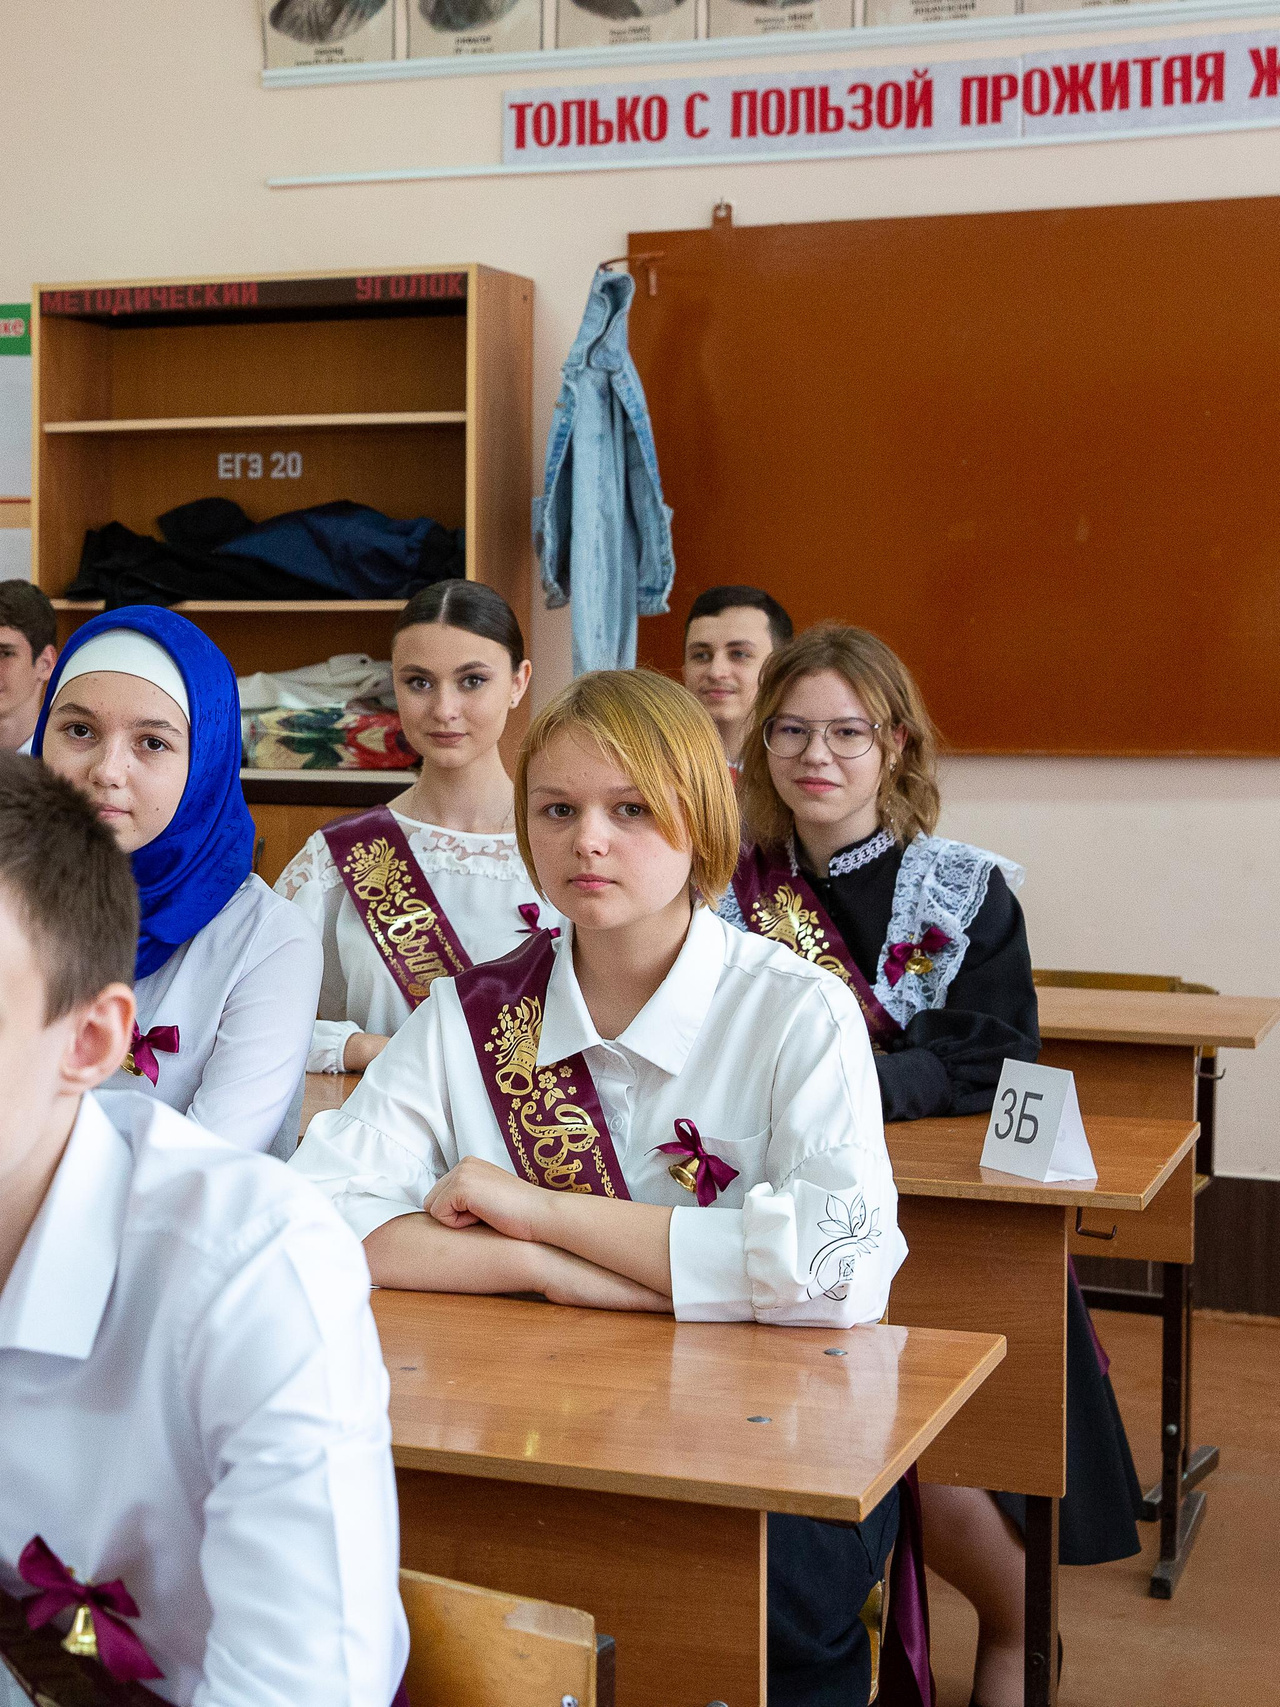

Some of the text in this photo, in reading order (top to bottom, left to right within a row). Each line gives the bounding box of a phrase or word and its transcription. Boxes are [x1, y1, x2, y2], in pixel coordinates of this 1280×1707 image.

[509, 94, 669, 150] ТОЛЬКО
[684, 92, 710, 139] С
[730, 68, 933, 139] ПОЛЬЗОЙ
[960, 50, 1226, 127] ПРОЖИТАЯ
[355, 274, 463, 300] УГОЛОК
[217, 450, 304, 480] ЕГЭ 20
[994, 1088, 1044, 1145] 3Б
